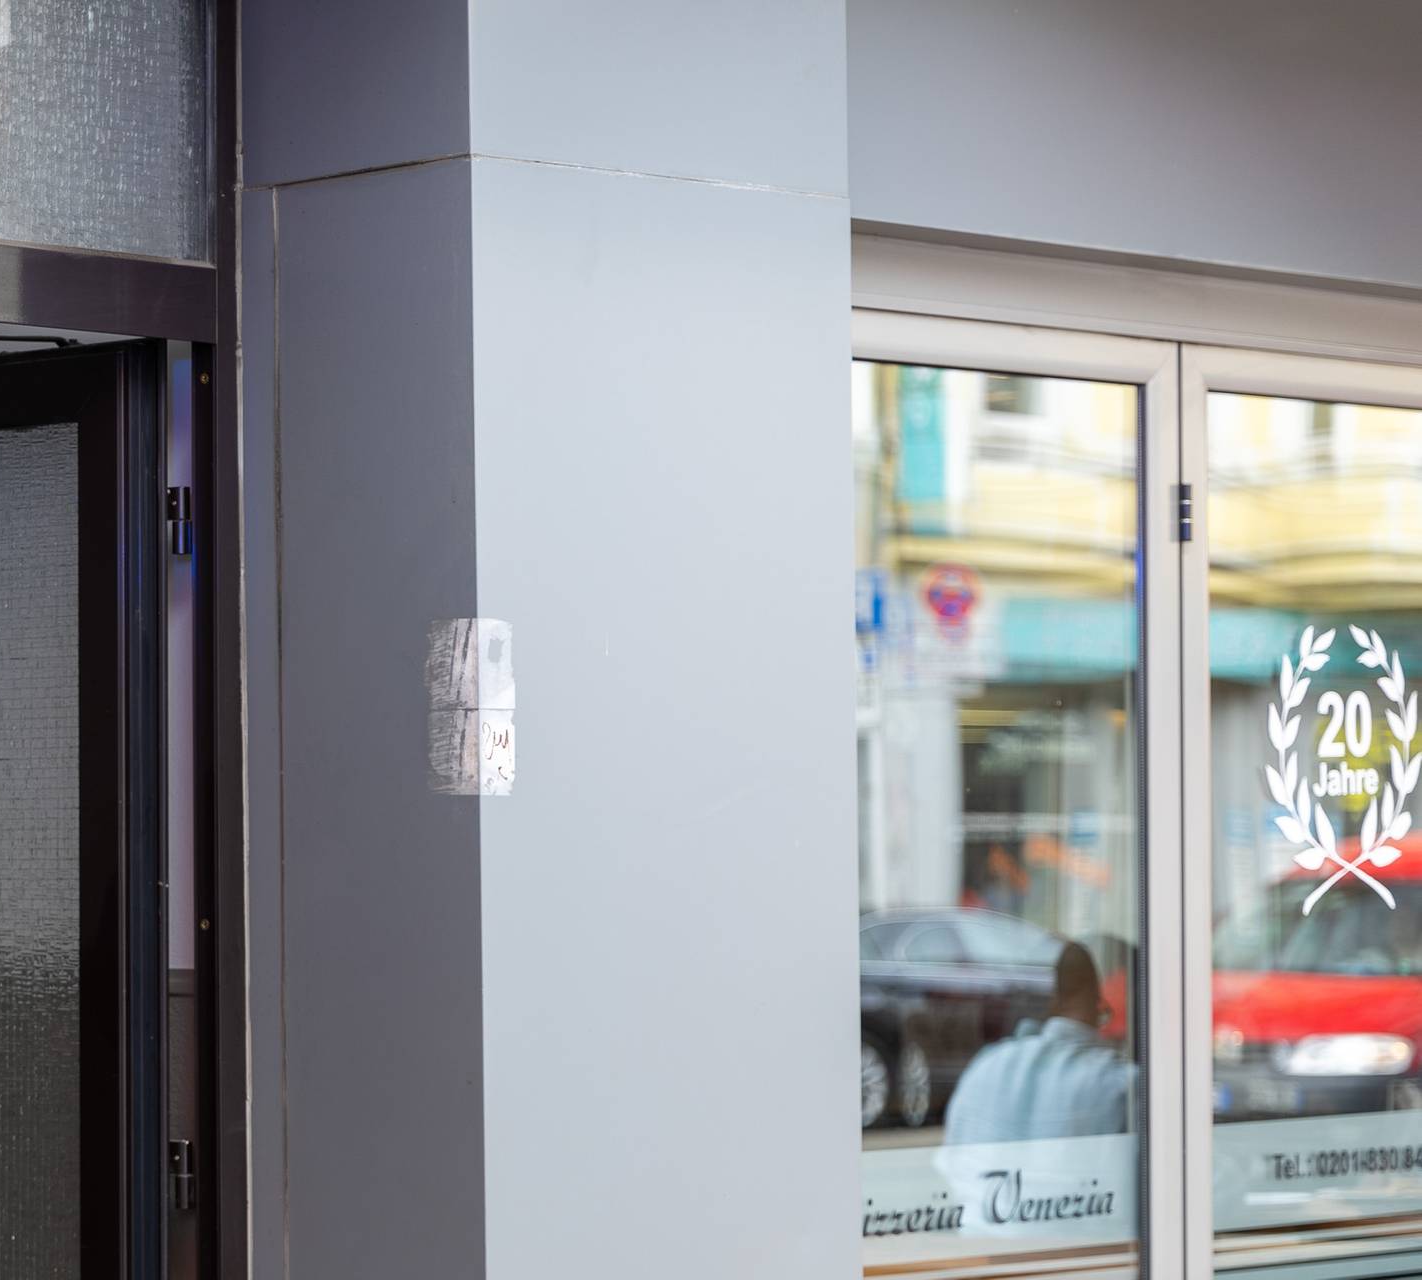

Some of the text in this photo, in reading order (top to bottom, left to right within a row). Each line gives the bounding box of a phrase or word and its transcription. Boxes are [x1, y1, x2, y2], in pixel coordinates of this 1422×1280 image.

[1317, 690, 1372, 758] 20
[1313, 761, 1379, 797] Jahre
[862, 1168, 1116, 1238] izzeria Venezia
